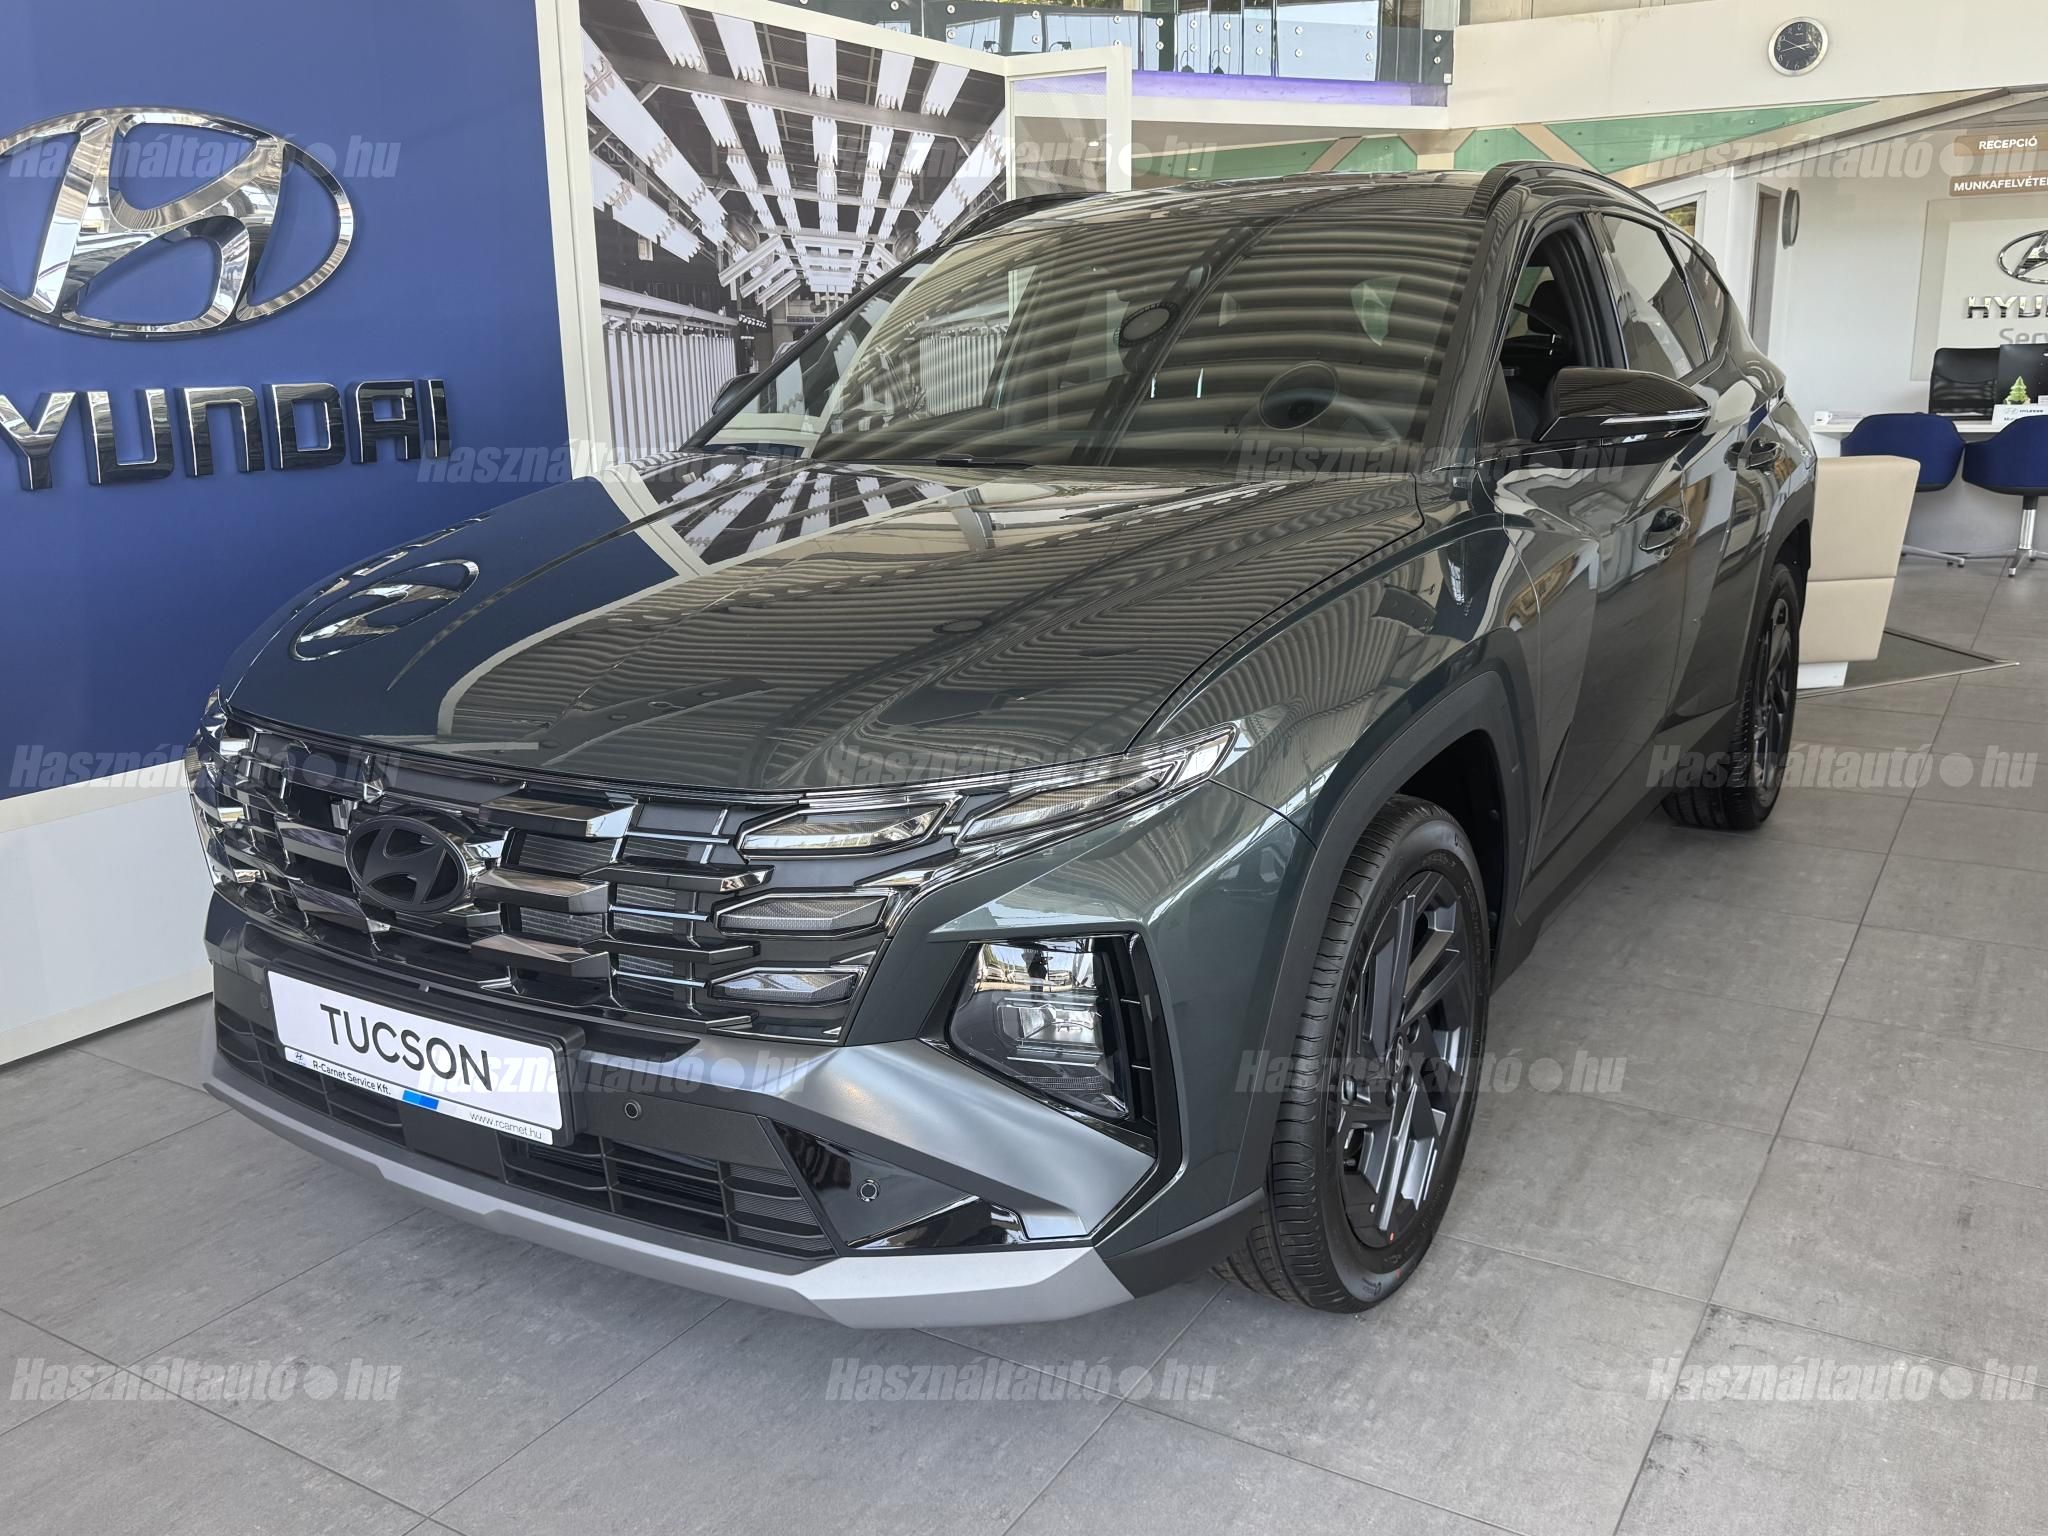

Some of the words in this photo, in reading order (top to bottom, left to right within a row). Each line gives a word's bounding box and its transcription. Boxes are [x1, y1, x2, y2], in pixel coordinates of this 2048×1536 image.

[1979, 136, 2038, 150] RECEPCIÓ
[1954, 176, 2048, 191] MUNKAFELVÉTE
[1967, 296, 2048, 318] HYU
[1999, 328, 2048, 345] Ser
[320, 1004, 493, 1091] TUCSON
[312, 1060, 346, 1080] R-Carnet
[347, 1073, 376, 1090] Service
[376, 1085, 392, 1096] Kft.
